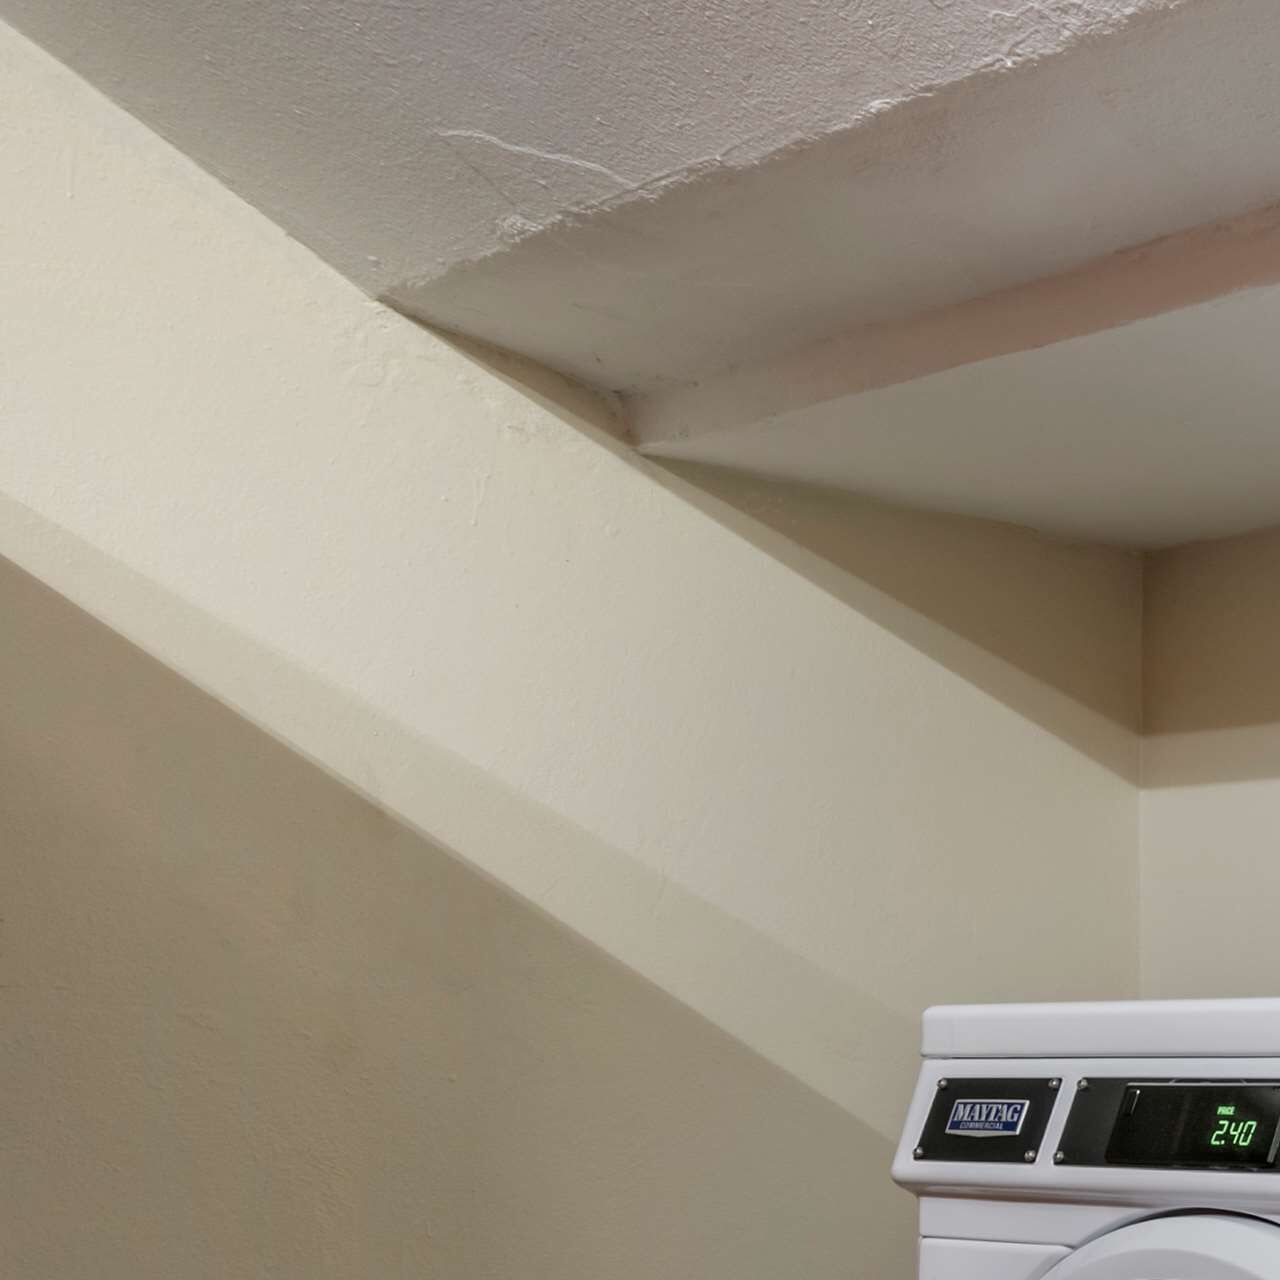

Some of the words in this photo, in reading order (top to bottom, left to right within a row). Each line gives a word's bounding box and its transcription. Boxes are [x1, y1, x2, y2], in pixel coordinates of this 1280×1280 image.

[954, 1103, 1021, 1122] MAYTAG
[959, 1120, 1004, 1130] COMMERCIAL
[1210, 1120, 1258, 1147] 2.40
